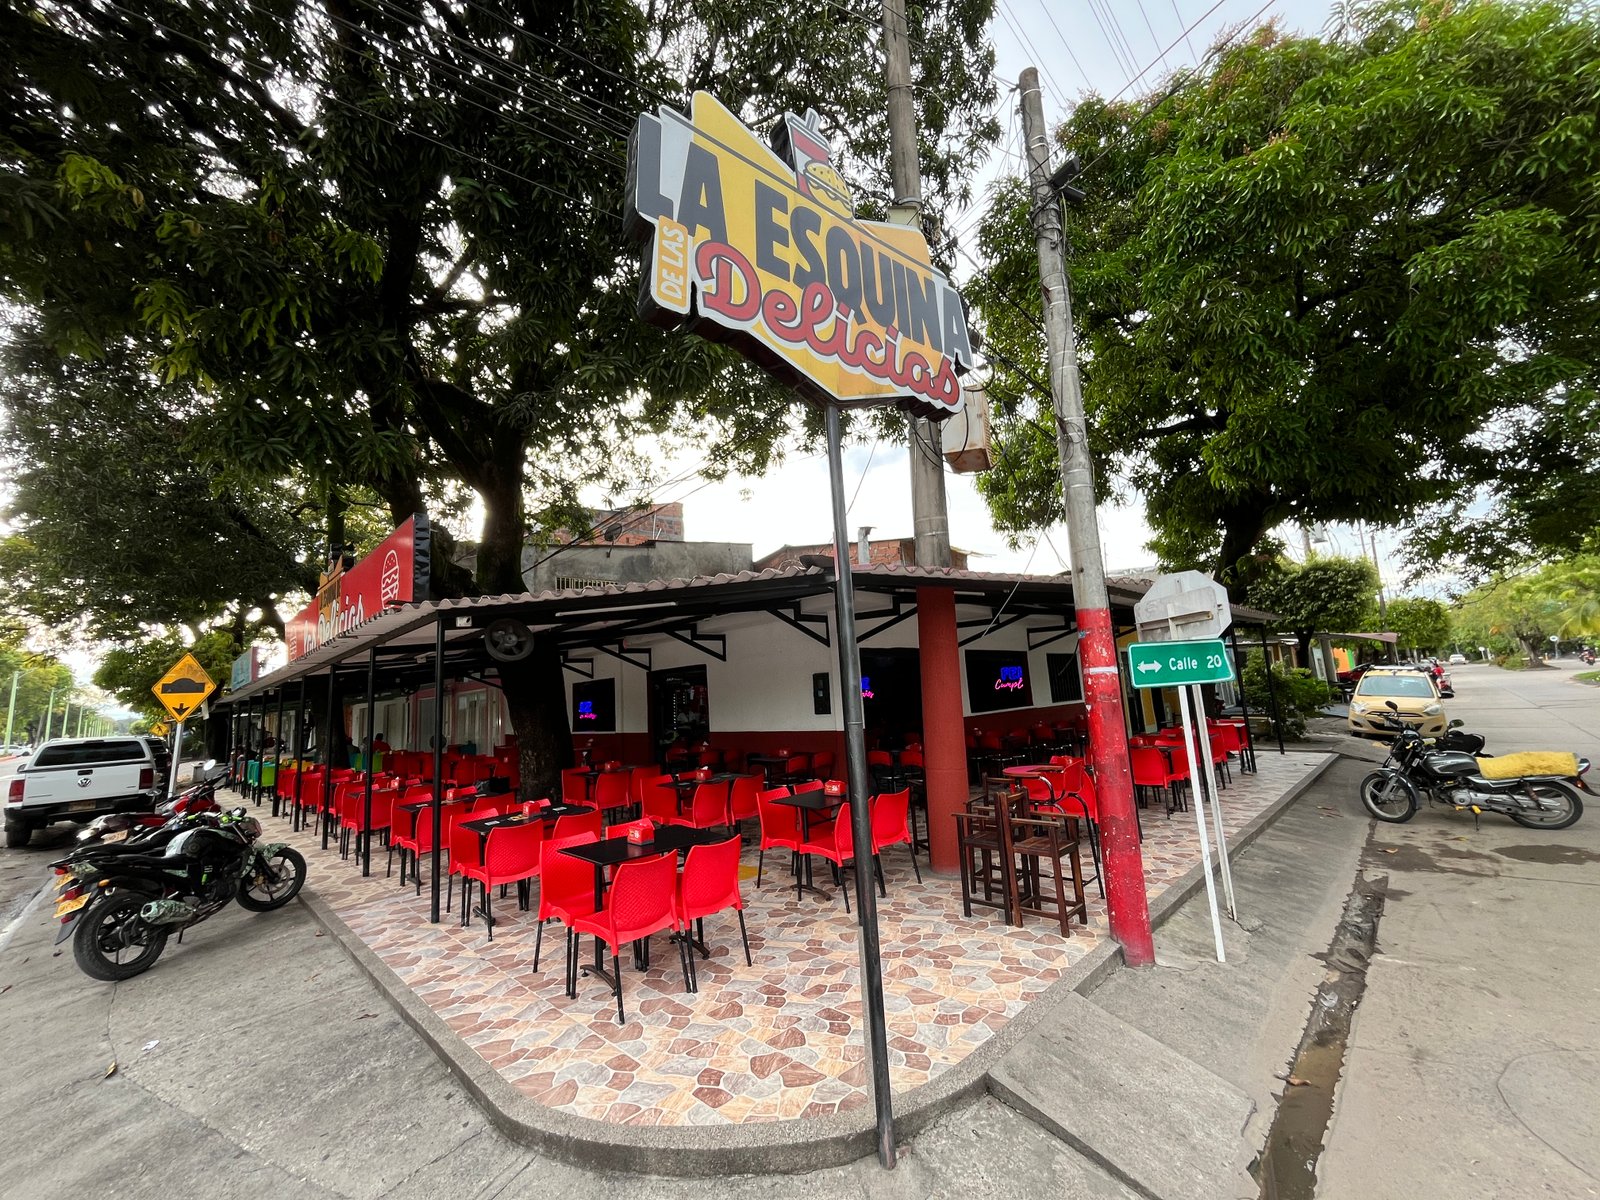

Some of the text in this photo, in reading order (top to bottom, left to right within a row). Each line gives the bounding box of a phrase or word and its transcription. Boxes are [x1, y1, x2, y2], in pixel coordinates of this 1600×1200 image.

[636, 113, 971, 367] LA ESQUINA
[661, 226, 685, 299] DE LAS
[695, 241, 961, 406] Delicias
[1168, 655, 1222, 671] Calle 20
